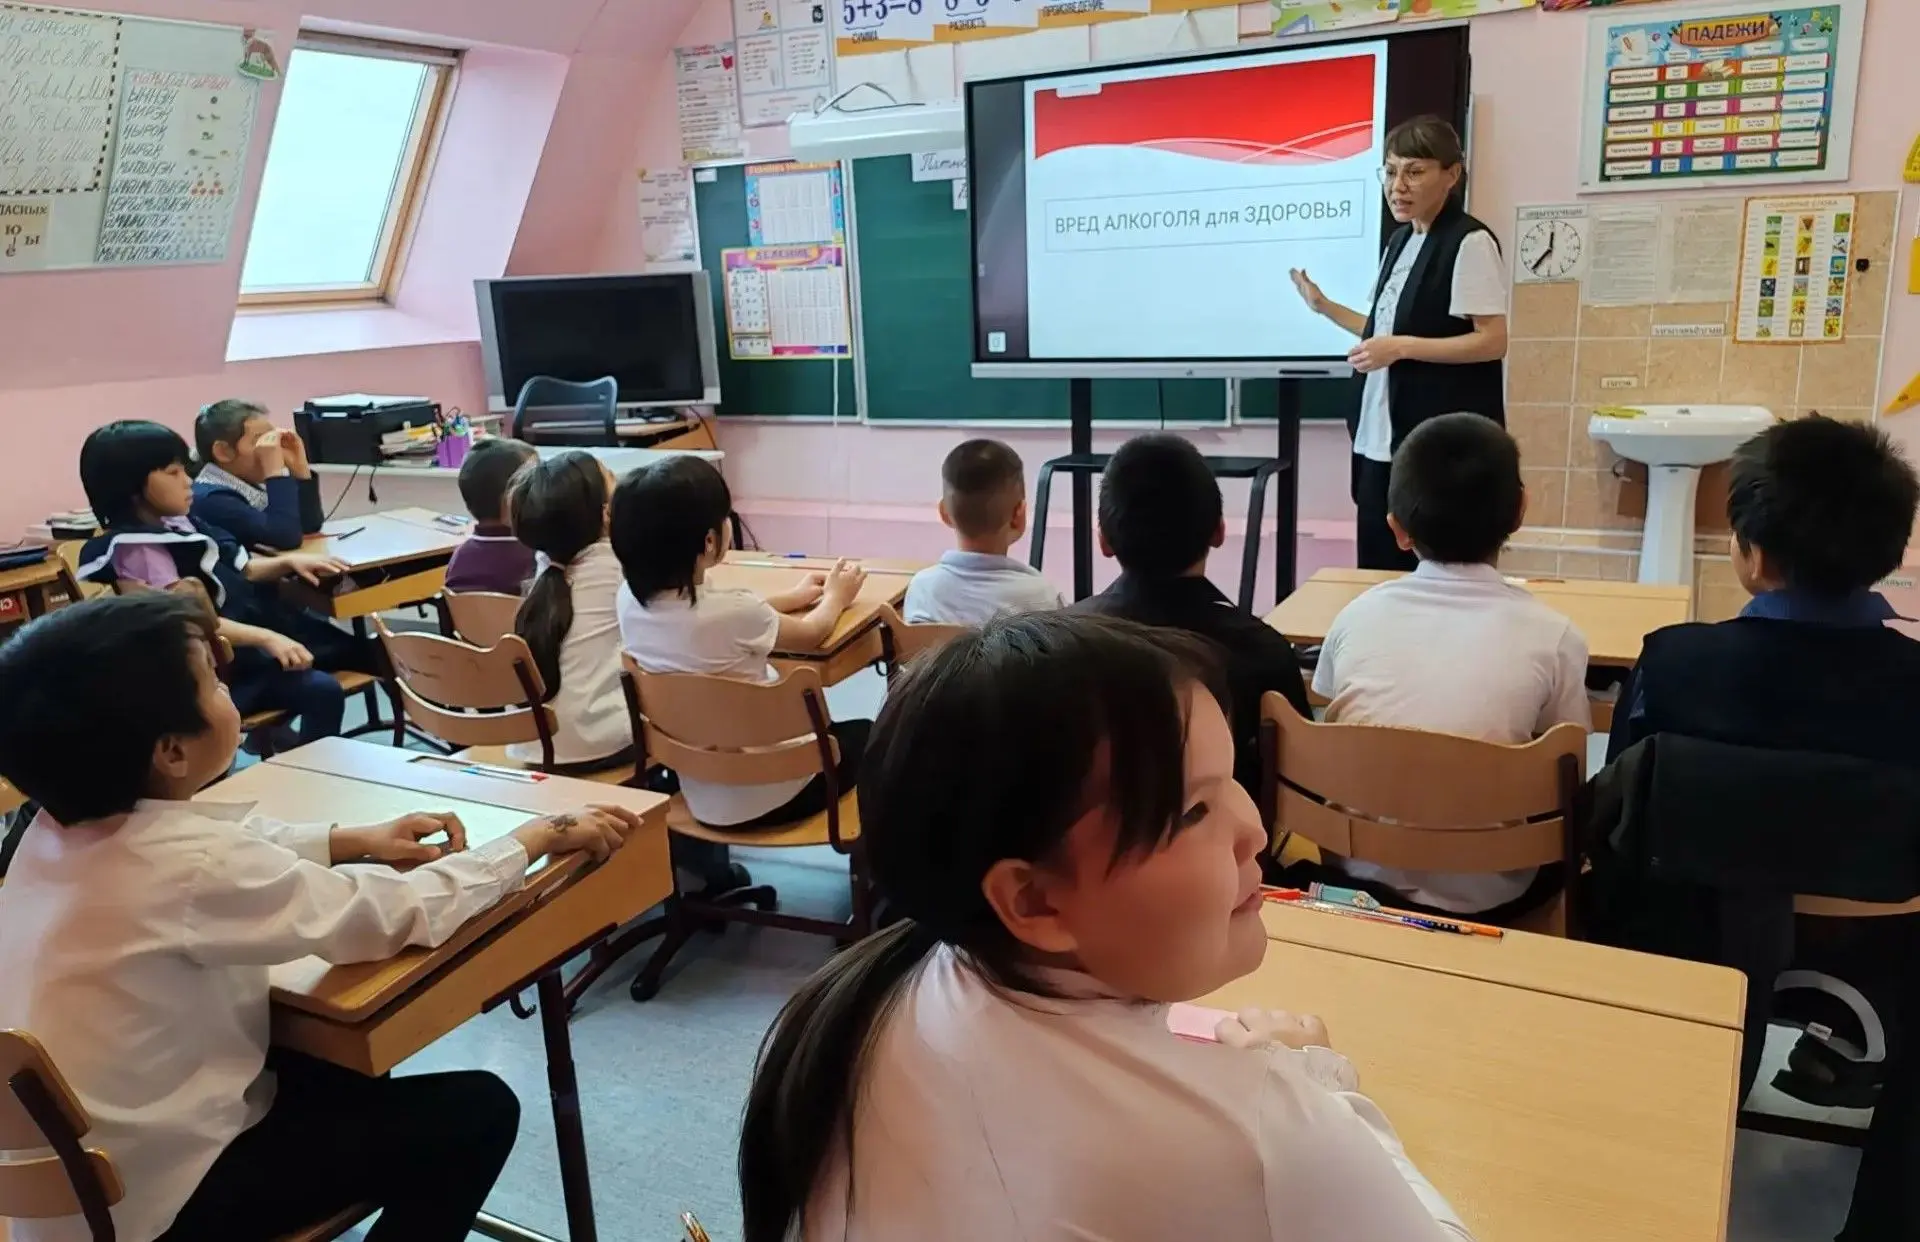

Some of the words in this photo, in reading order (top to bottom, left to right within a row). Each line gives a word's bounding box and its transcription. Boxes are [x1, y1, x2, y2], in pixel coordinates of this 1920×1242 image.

[1687, 20, 1765, 42] ПАДЕЖИ
[1055, 215, 1100, 235] ВРЕД
[1104, 209, 1201, 230] АЛКОГОЛЯ
[1204, 211, 1239, 227] для
[1243, 199, 1351, 225] ЗДОРОВЬЯ
